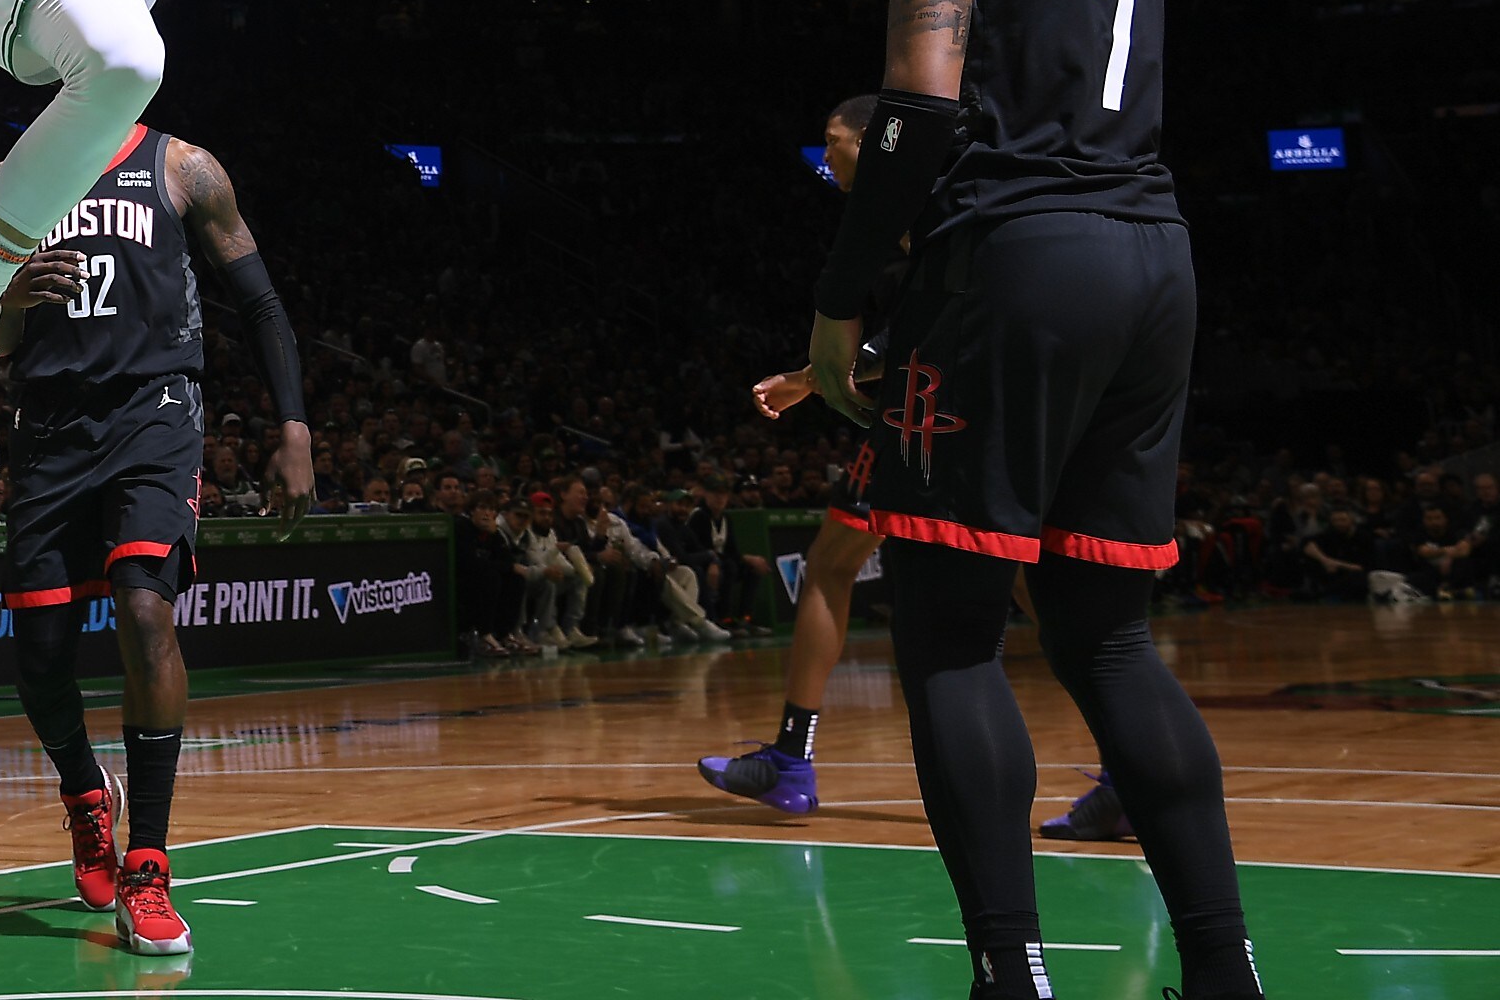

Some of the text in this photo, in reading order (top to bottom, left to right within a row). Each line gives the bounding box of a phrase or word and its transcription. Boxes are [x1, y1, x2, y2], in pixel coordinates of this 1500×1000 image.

[117, 178, 152, 188] karma
[118, 169, 152, 180] credit
[213, 579, 288, 625] PRINT
[291, 578, 320, 620] IT.
[353, 573, 431, 613] vistaprint
